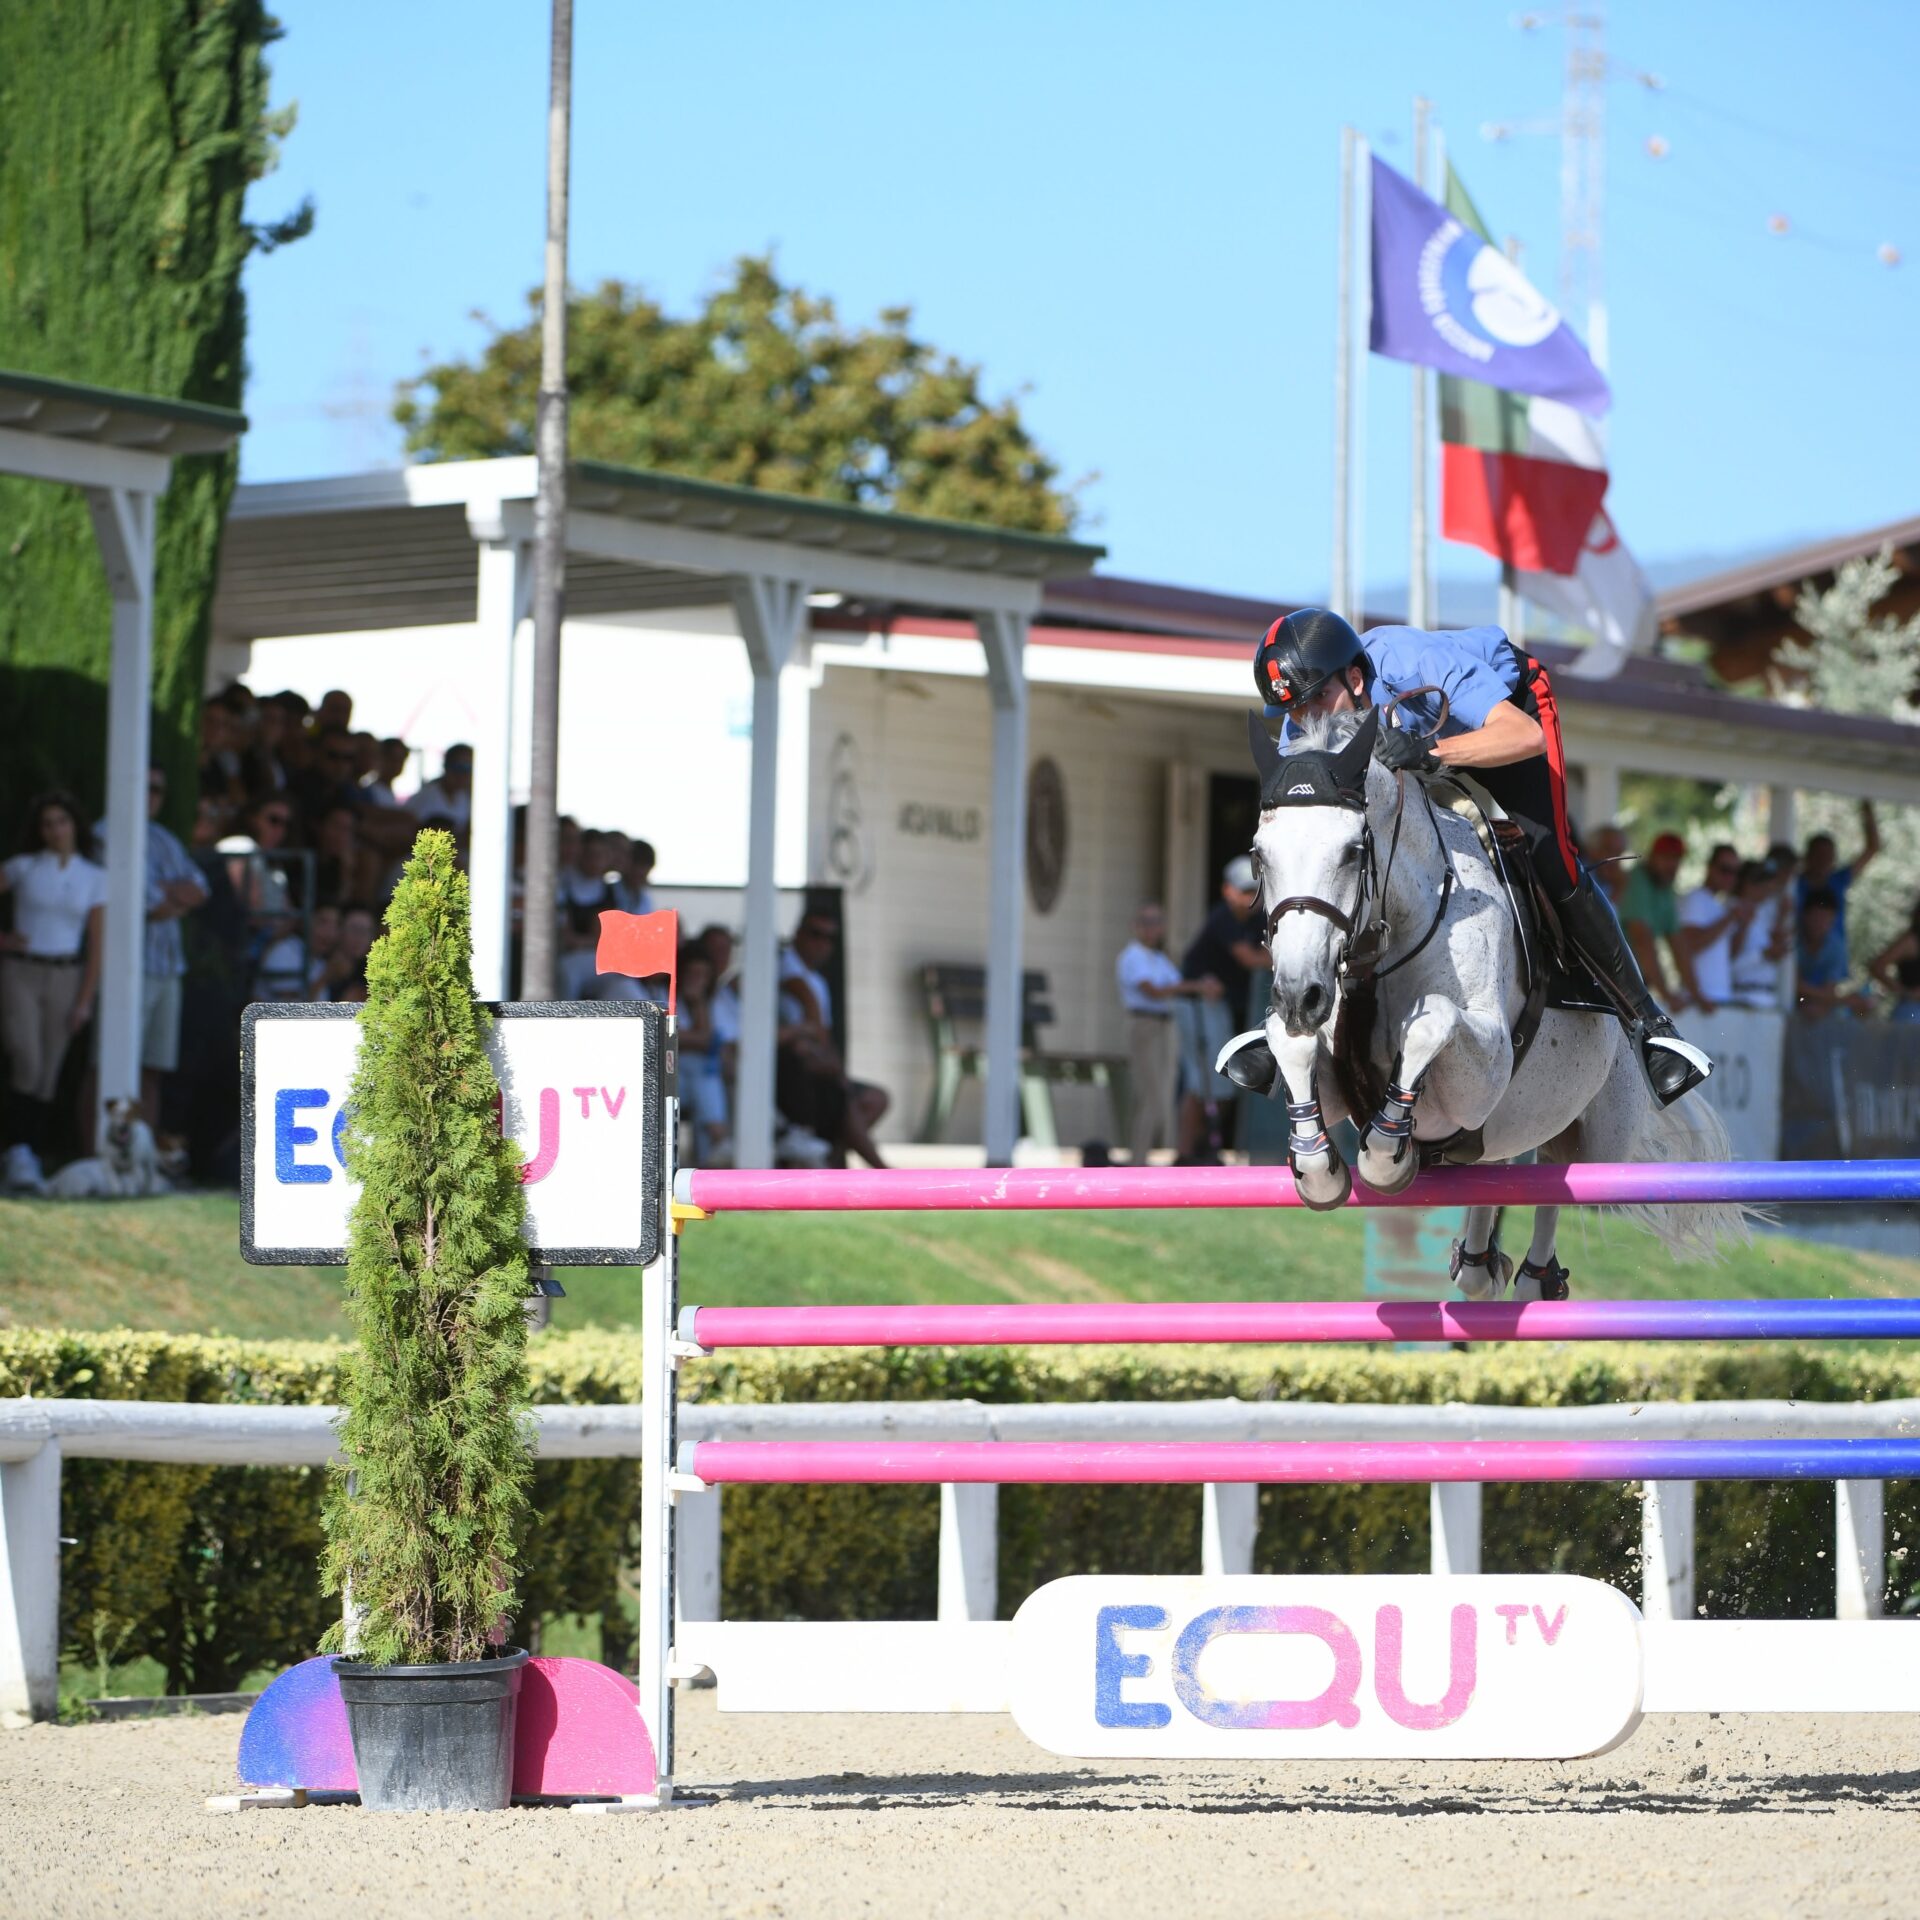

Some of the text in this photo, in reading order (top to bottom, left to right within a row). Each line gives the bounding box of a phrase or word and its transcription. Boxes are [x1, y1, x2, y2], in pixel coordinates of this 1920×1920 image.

[275, 1086, 626, 1185] EU TV
[1095, 1603, 1569, 1731] EQU TV
